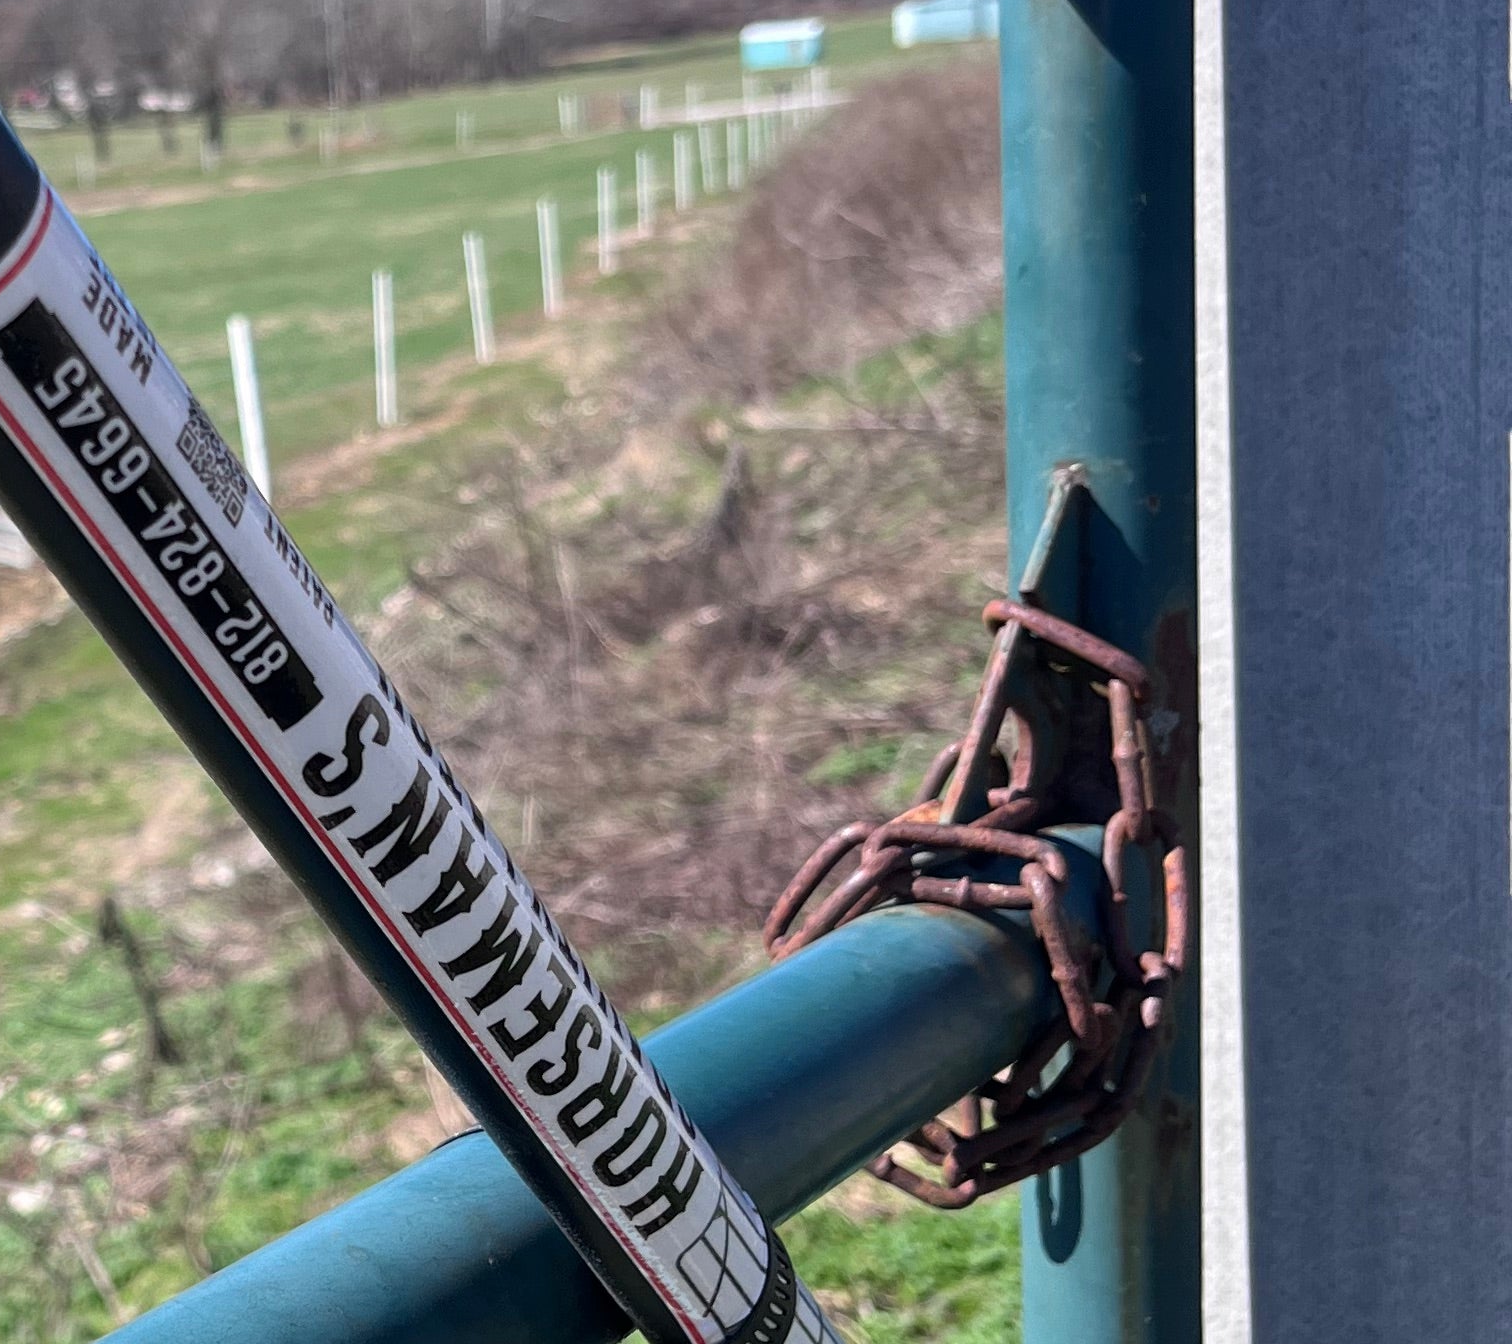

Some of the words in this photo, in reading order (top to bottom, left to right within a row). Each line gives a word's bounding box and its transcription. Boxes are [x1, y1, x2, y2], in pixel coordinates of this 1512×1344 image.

[82, 273, 153, 384] MADE
[34, 357, 289, 685] 812-824-6645
[263, 513, 331, 628] PATENT
[300, 692, 703, 1238] HORSEMAN'S
